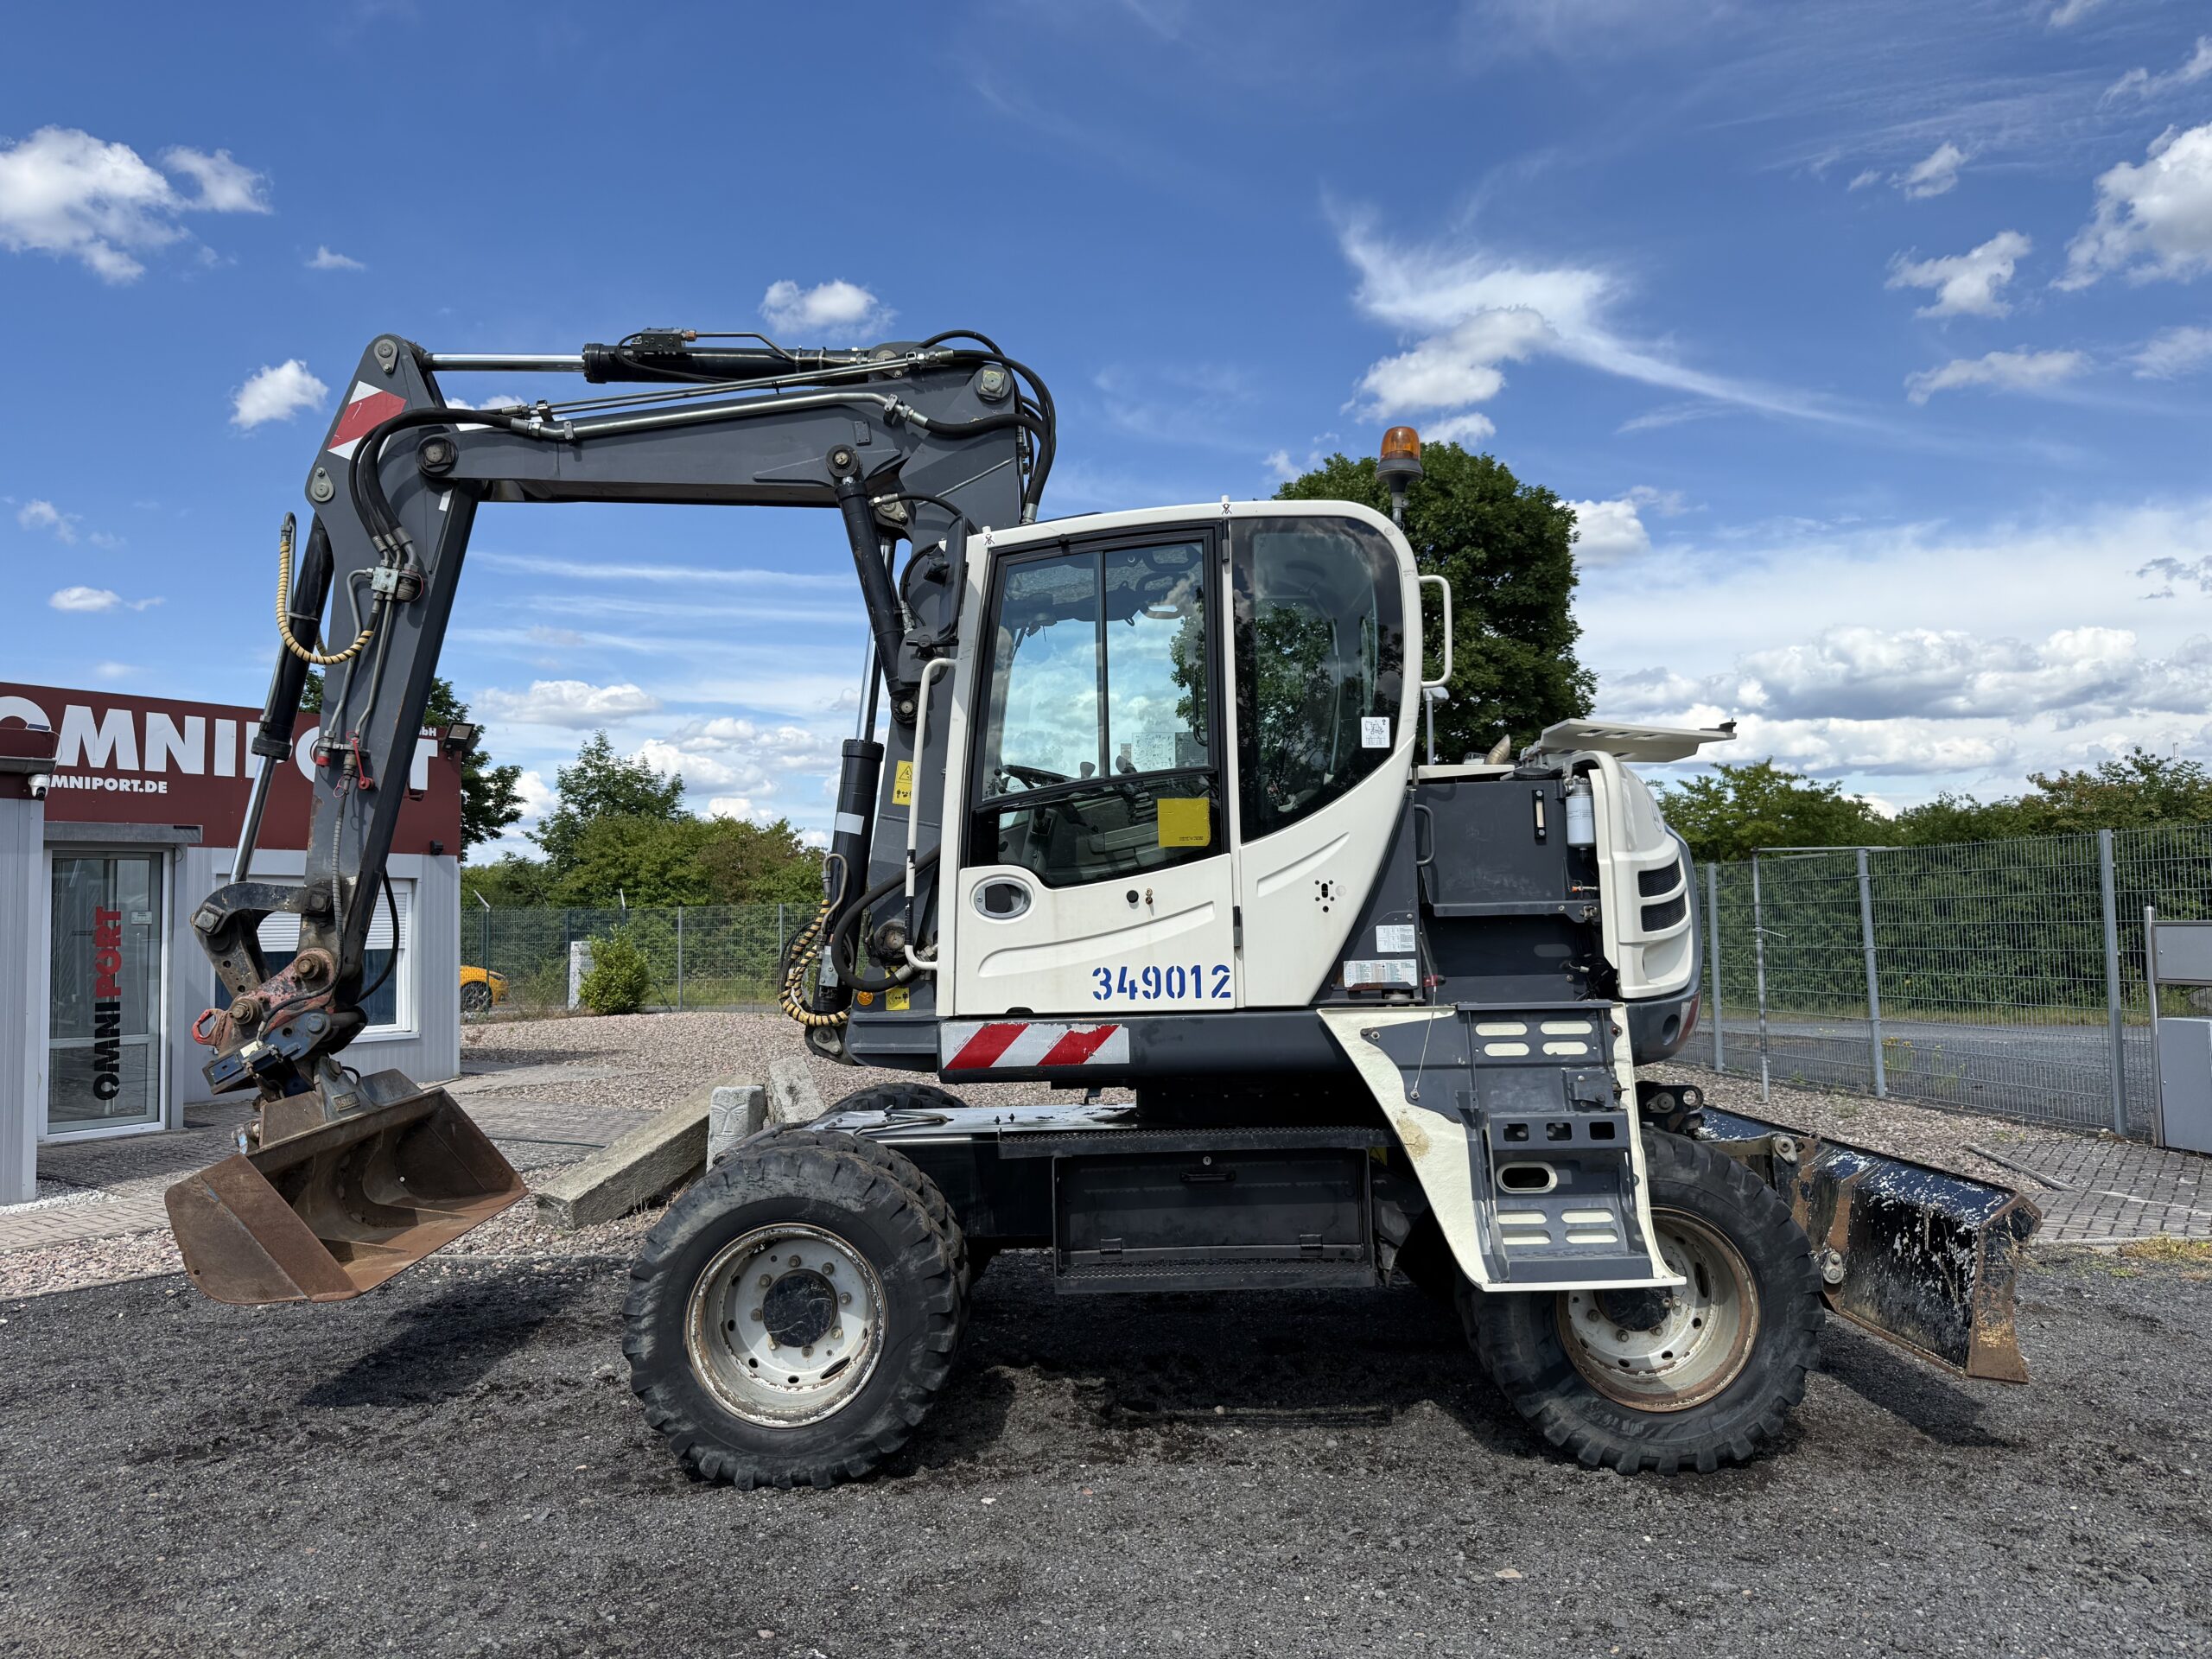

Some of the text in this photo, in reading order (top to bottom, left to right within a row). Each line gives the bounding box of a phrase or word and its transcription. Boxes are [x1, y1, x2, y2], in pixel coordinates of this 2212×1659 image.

[50, 774, 168, 794] MNIPORT.DE
[1092, 964, 1231, 1001] 349012
[92, 906, 122, 1101] OMNIPORT
